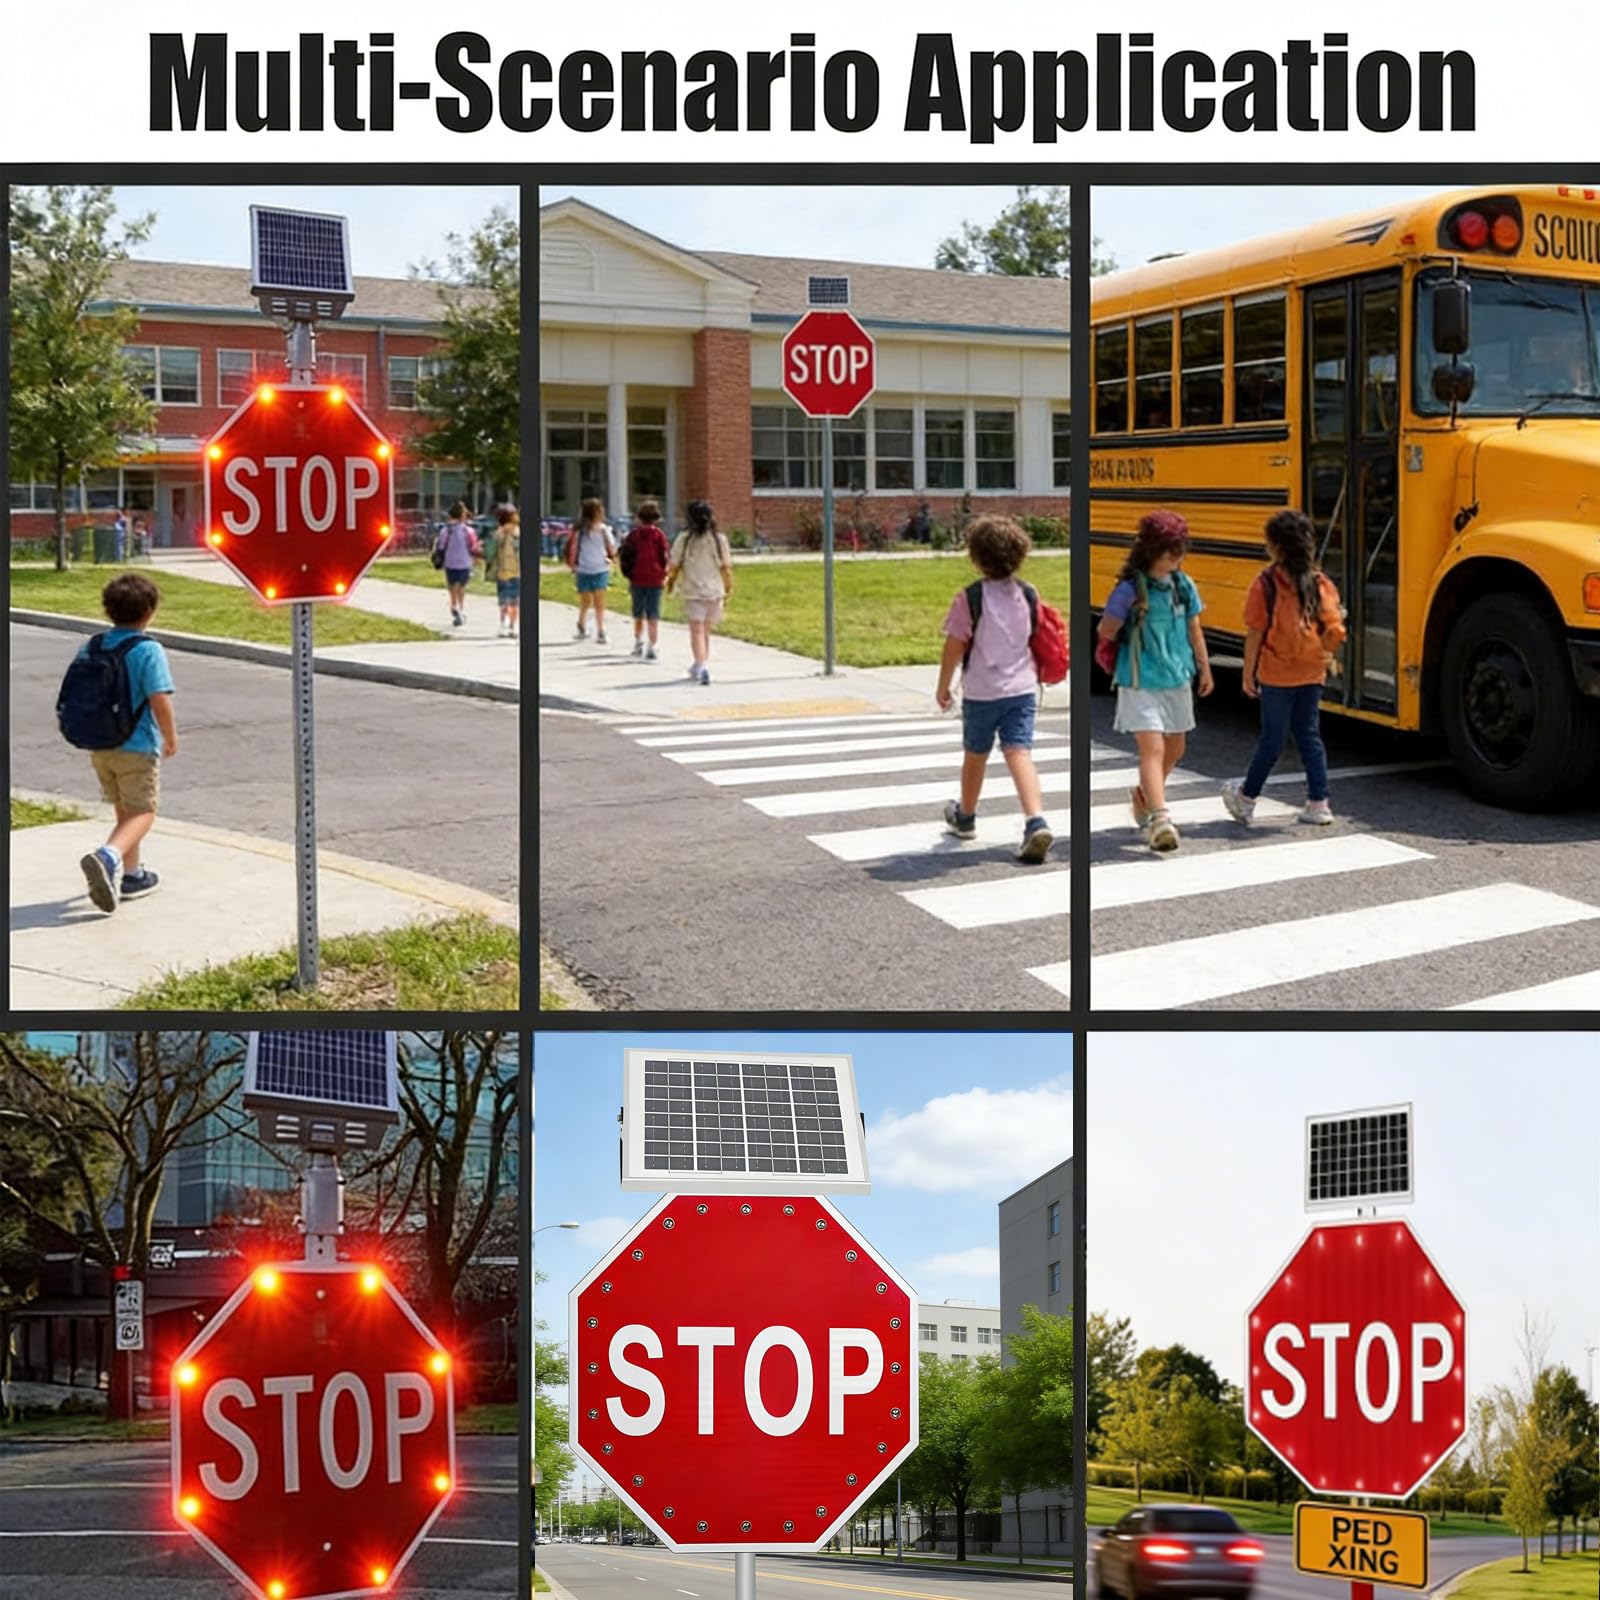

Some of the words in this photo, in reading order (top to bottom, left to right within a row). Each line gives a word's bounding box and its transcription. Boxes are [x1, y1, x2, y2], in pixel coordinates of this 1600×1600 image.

[790, 344, 870, 385] STOP
[222, 455, 379, 535] STOP
[605, 1324, 884, 1437] STOP
[1261, 1321, 1454, 1423] STOP
[198, 1371, 433, 1500] STOP
[1327, 1543, 1399, 1576] XING
[1332, 1516, 1393, 1546] PED
